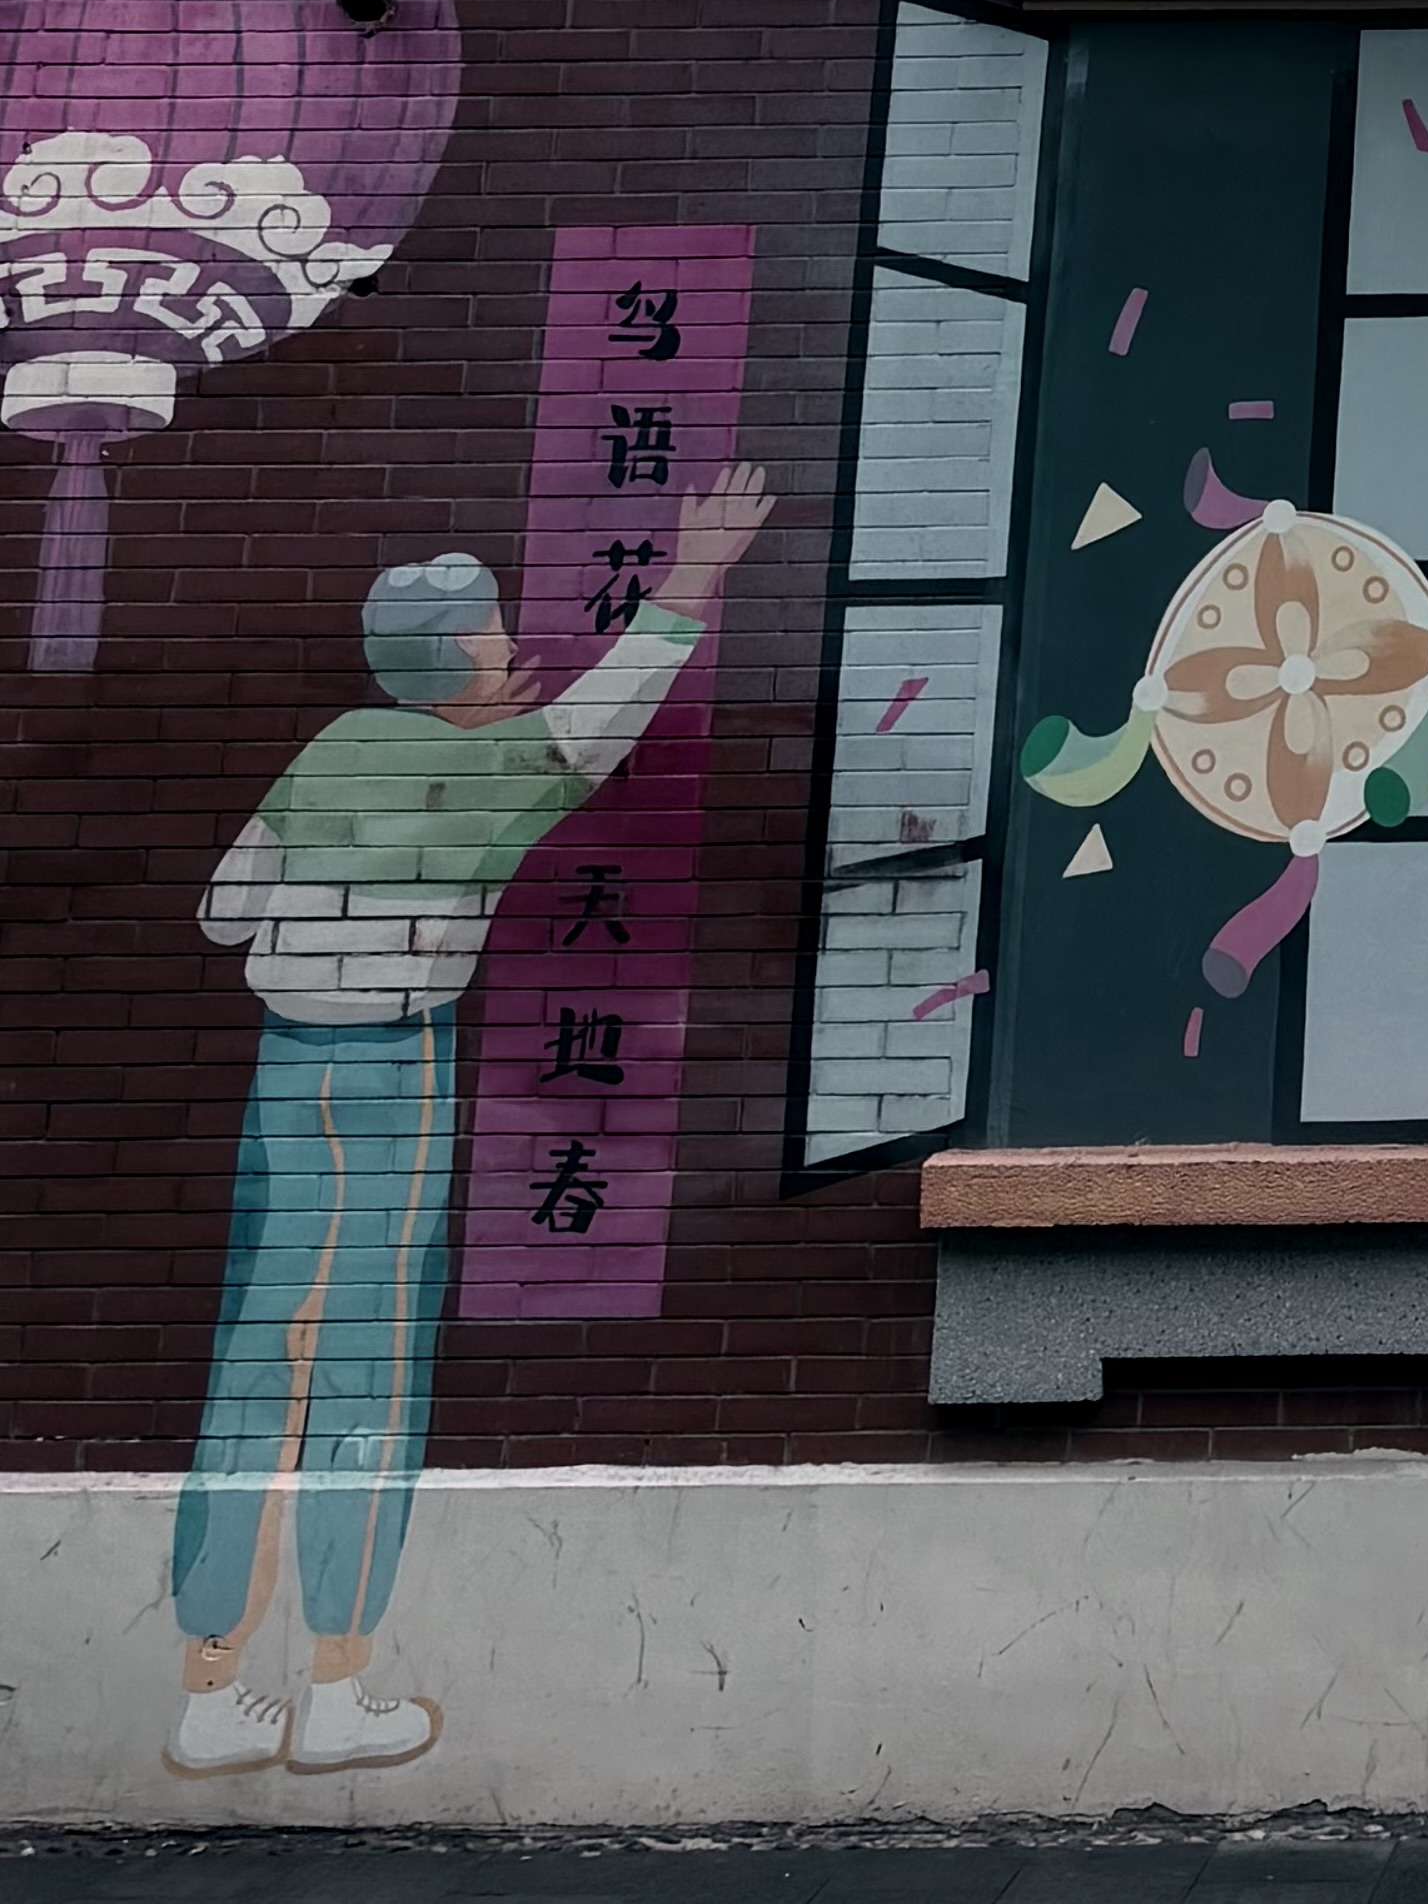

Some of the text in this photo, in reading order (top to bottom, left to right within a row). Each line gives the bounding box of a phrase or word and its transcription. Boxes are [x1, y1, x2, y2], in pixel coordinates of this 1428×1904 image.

[529, 280, 681, 1234] 鸟语花天地春
